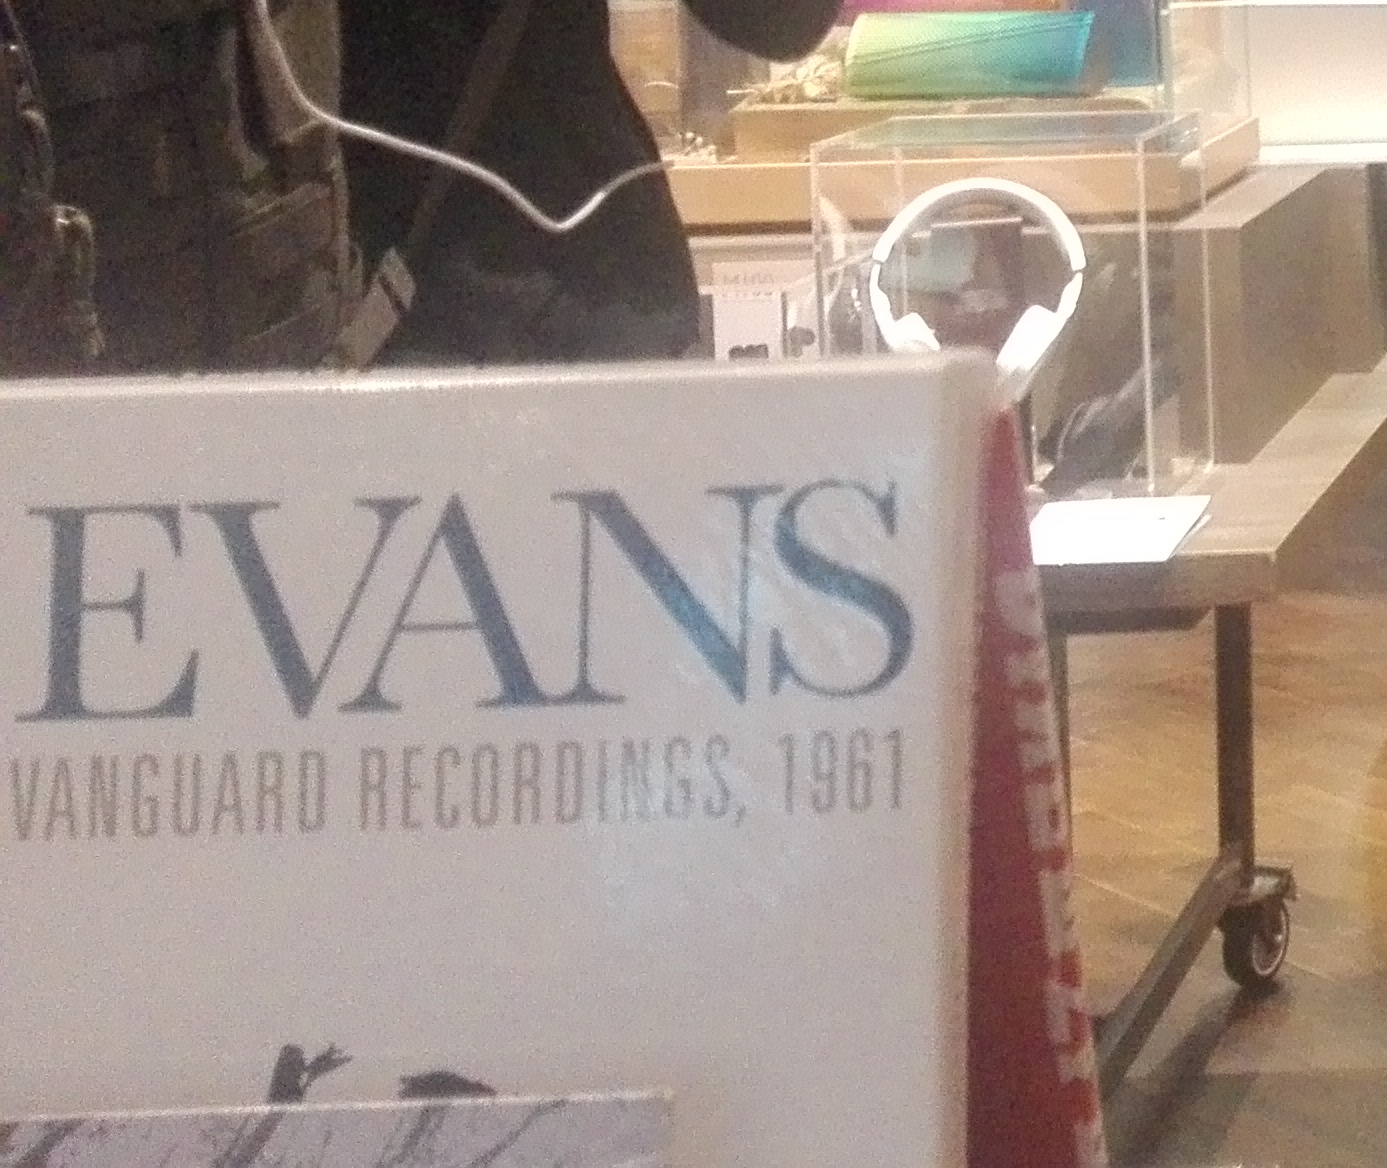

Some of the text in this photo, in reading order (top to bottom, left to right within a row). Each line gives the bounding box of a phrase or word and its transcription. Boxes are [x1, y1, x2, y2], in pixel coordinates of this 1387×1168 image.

[15, 478, 916, 724] EVANS
[8, 727, 907, 842] VANGUARD RECORDINGS, 1961
